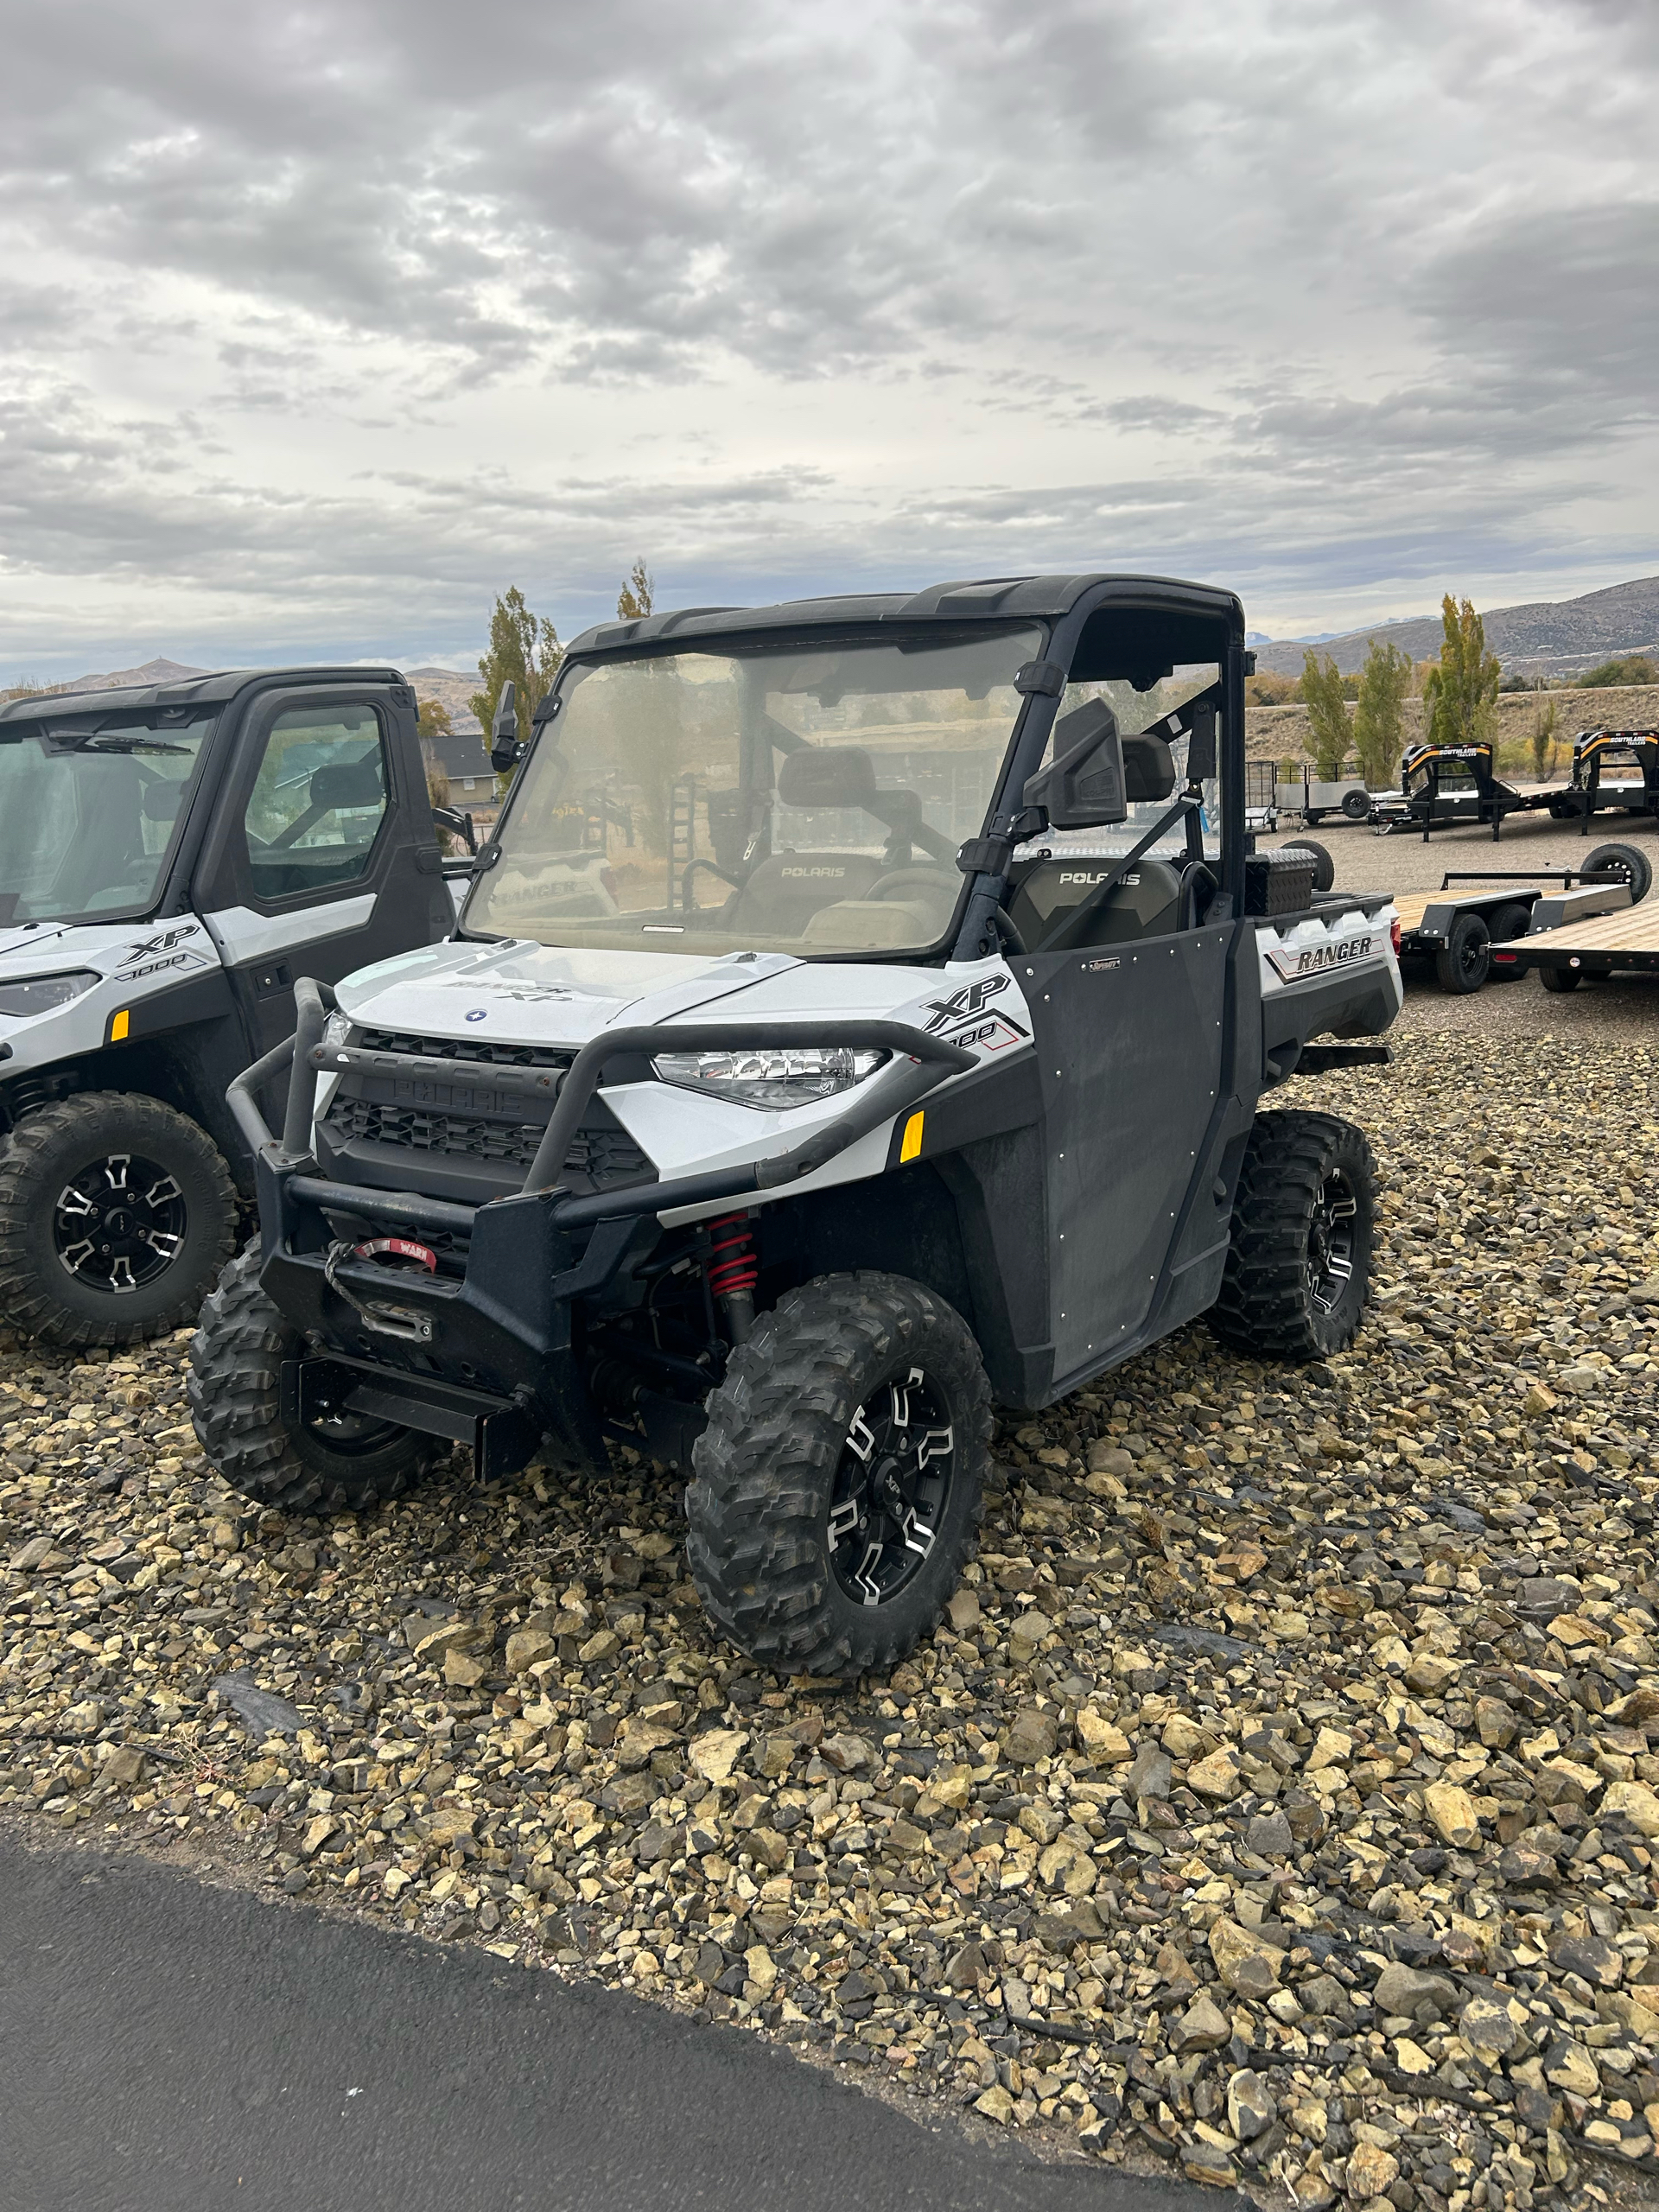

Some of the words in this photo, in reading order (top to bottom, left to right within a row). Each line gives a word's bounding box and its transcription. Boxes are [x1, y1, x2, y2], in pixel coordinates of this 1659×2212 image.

[781, 867, 845, 877] POLARIS
[1059, 873, 1141, 886] POLAIS
[116, 924, 200, 968] XP
[1296, 935, 1372, 974] RANGER
[130, 952, 188, 980] 1000
[489, 991, 574, 1002] XP
[918, 972, 1012, 1034] XP
[393, 1078, 524, 1116] POLARIS
[400, 1242, 428, 1261] WARN
[885, 1474, 900, 1494] XP
